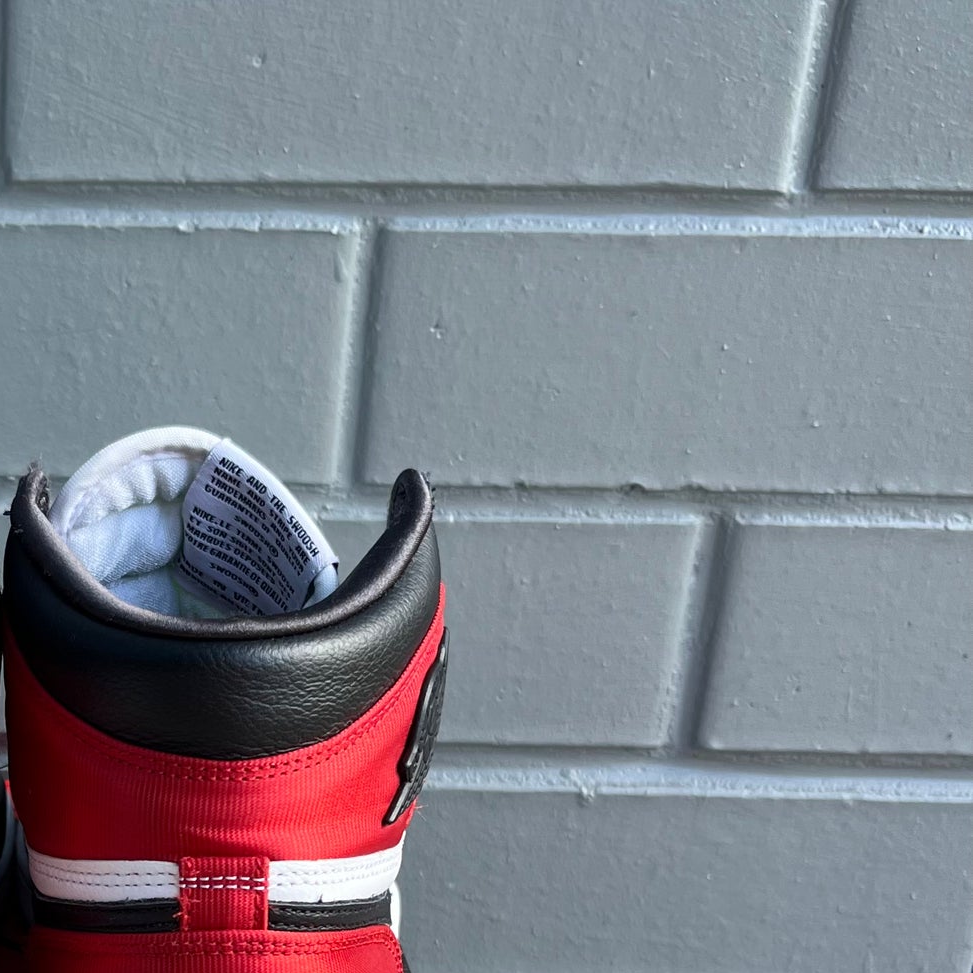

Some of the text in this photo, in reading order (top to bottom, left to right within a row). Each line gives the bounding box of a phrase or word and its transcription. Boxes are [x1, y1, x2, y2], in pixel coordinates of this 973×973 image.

[204, 484, 259, 524] GUARANTEE
[210, 475, 266, 520] TRADEMARKS
[270, 522, 285, 542] AND
[213, 466, 311, 566] NAME AND STRIPE ARE
[218, 457, 320, 557] NIKE AND THE SWOOSH
[187, 522, 232, 550] MARQUES
[190, 515, 202, 526] ET
[207, 525, 228, 538] SON
[210, 548, 250, 576] GARANTIE
[249, 572, 262, 585] DE
